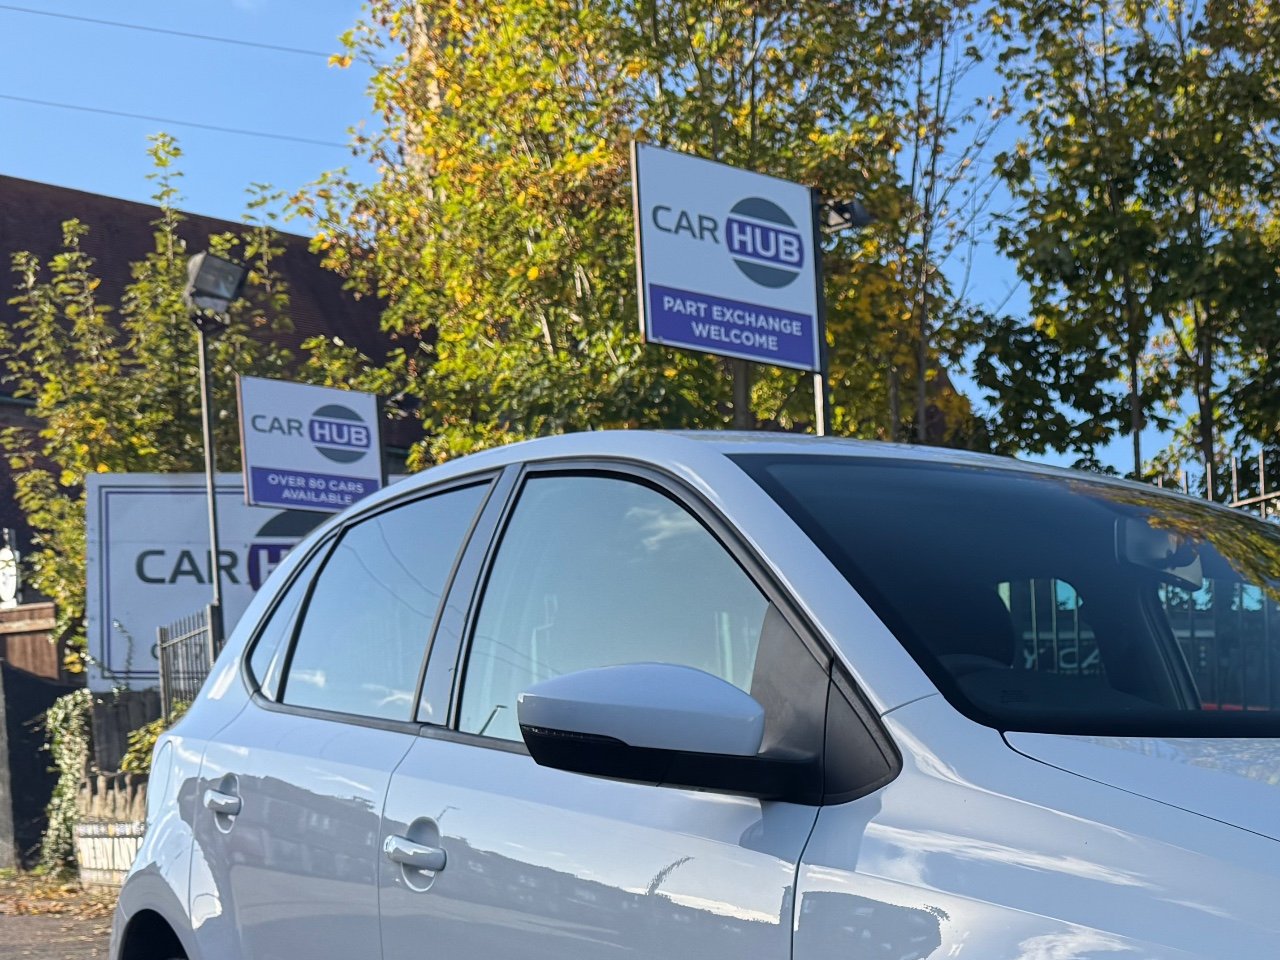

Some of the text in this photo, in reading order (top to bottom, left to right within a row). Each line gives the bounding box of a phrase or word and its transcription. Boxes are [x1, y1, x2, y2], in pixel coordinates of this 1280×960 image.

[652, 205, 801, 264] CAR HUB
[663, 296, 802, 336] PART EXCHANGE
[691, 321, 778, 351] WELCOME
[251, 414, 369, 447] CAR HUB
[267, 474, 364, 494] OVER 80 CARS
[281, 487, 352, 505] AVAILABLE
[135, 549, 241, 585] CAR
